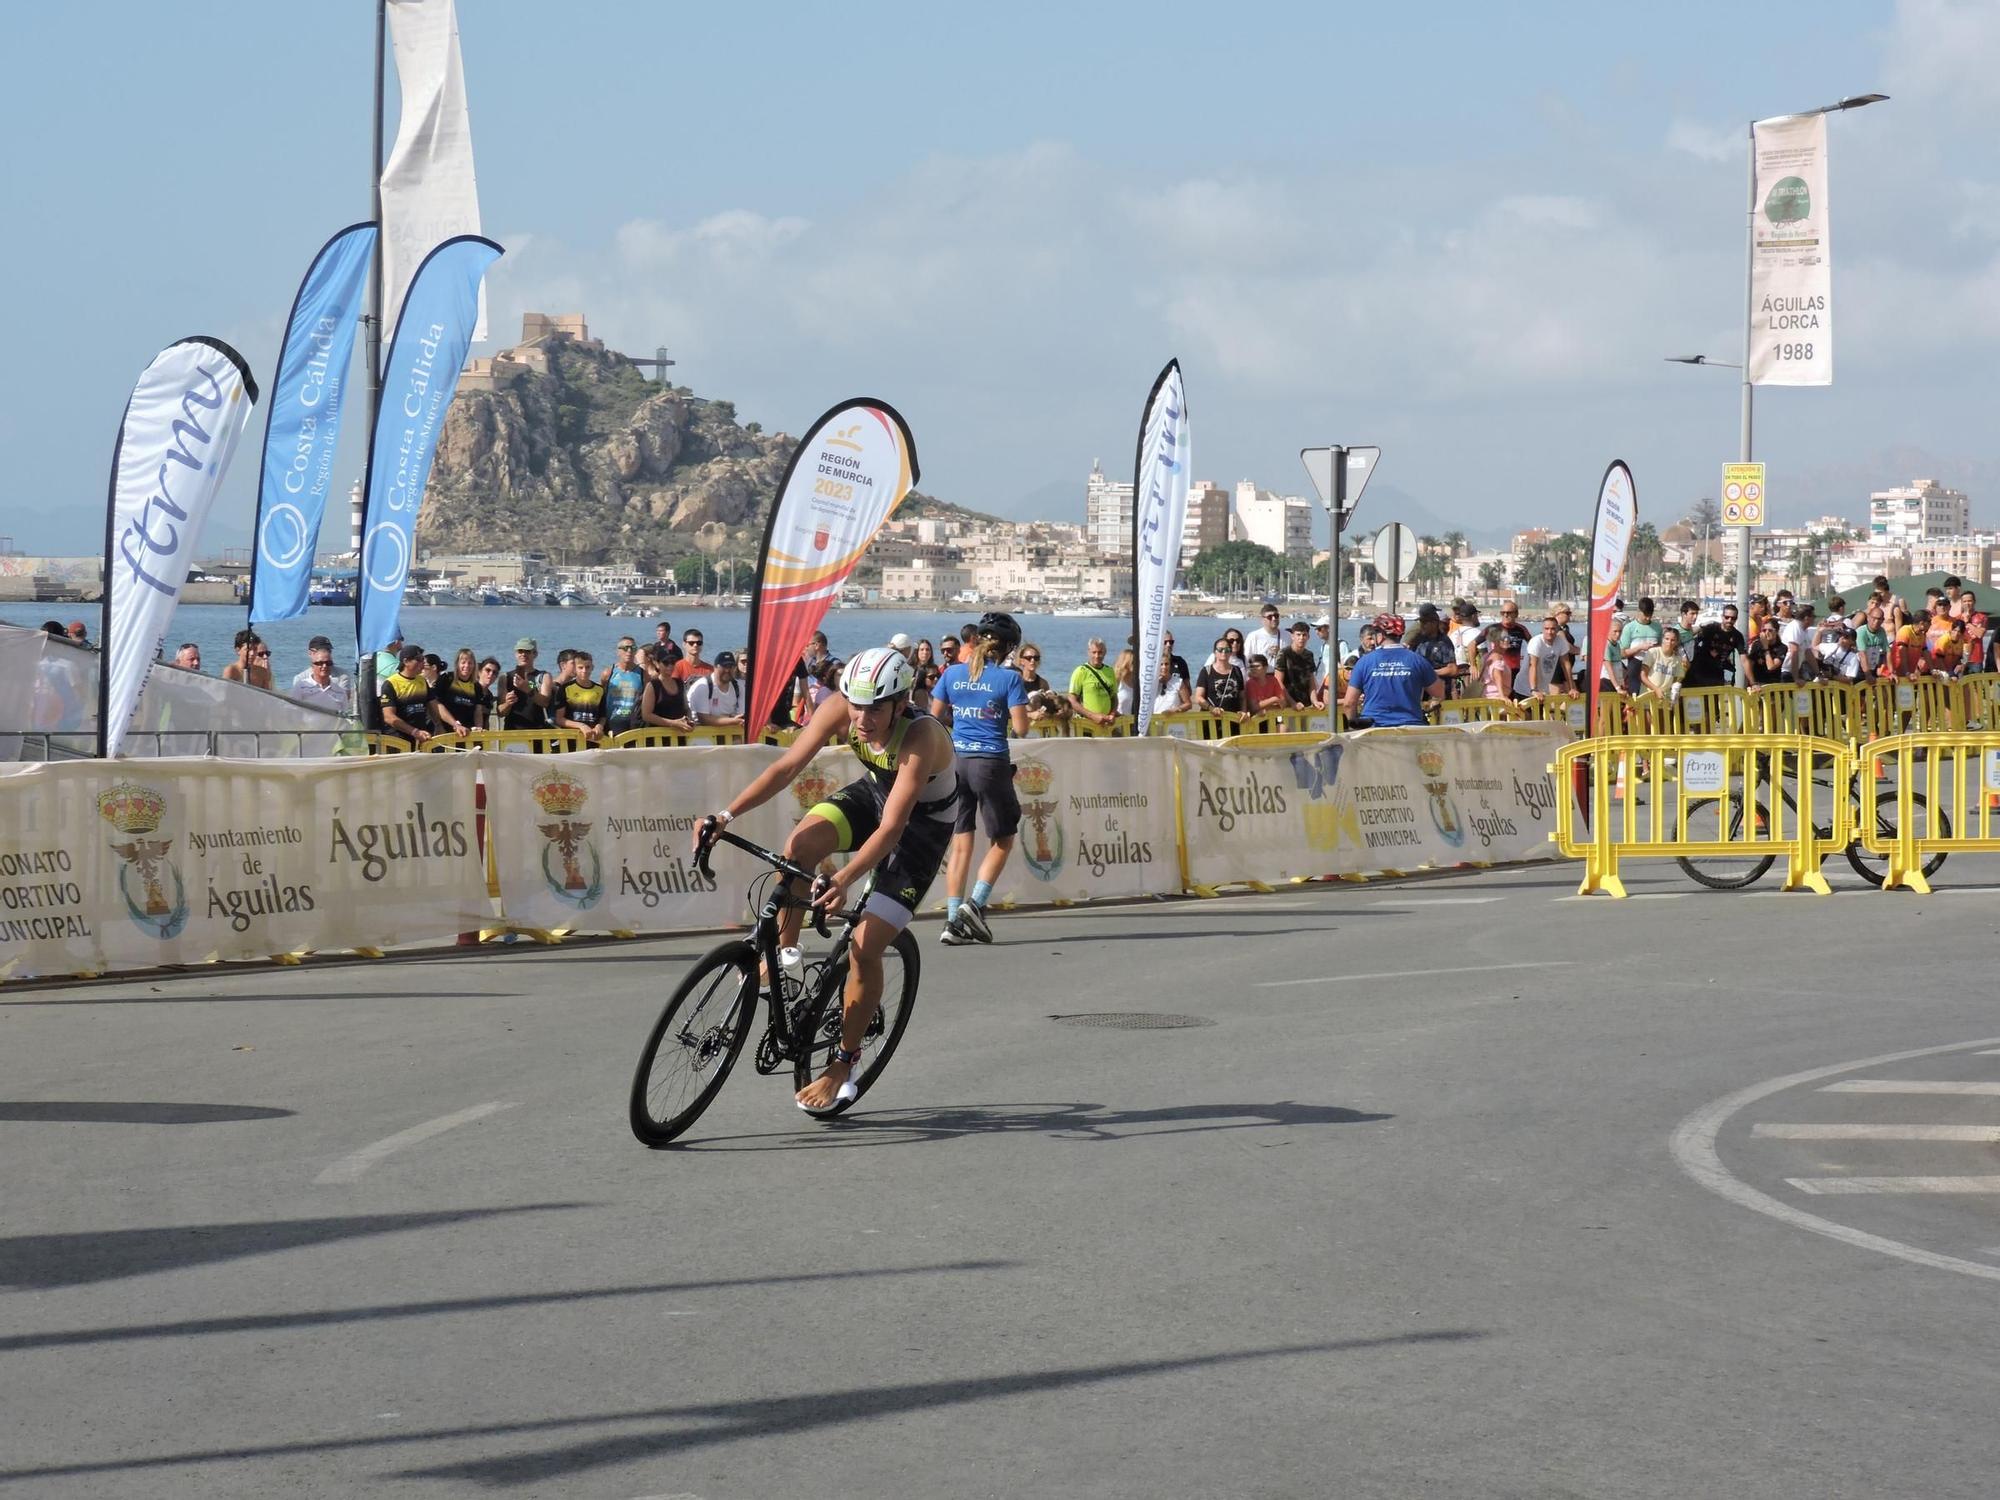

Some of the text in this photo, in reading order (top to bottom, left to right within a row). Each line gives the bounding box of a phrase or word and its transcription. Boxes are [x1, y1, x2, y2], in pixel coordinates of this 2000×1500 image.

[1761, 294, 1825, 312] ÁGUILAS
[1769, 314, 1819, 330] LORCA
[1773, 343, 1814, 361] 1988
[285, 316, 336, 494] Costa Cálida
[387, 323, 445, 511] Costa Cálida
[310, 377, 340, 497] Región de Murcia
[820, 451, 861, 469] REGIÓN
[818, 463, 873, 487] DE MURCIA
[814, 477, 854, 502] 2023
[1138, 584, 1165, 736] ederación de Triatlón
[953, 681, 993, 692] OFICIAL
[1069, 792, 1148, 816] Ayuntamiento
[1197, 771, 1287, 832] Águilas
[1354, 785, 1408, 803] PATRONATO
[1511, 768, 1575, 821] Águil
[1105, 813, 1119, 832] de
[1360, 807, 1414, 826] DEPORTIVO
[1467, 808, 1518, 848] Águilas
[188, 826, 303, 857] Ayuntamiento
[330, 802, 468, 882] Águilas
[653, 837, 672, 858] de
[1364, 830, 1422, 849] MUNICIPAL
[0, 850, 72, 876] ONATO
[242, 852, 262, 876] de
[1077, 830, 1152, 878] Águilas
[620, 857, 718, 908] Águilas
[207, 872, 315, 932] Águilas
